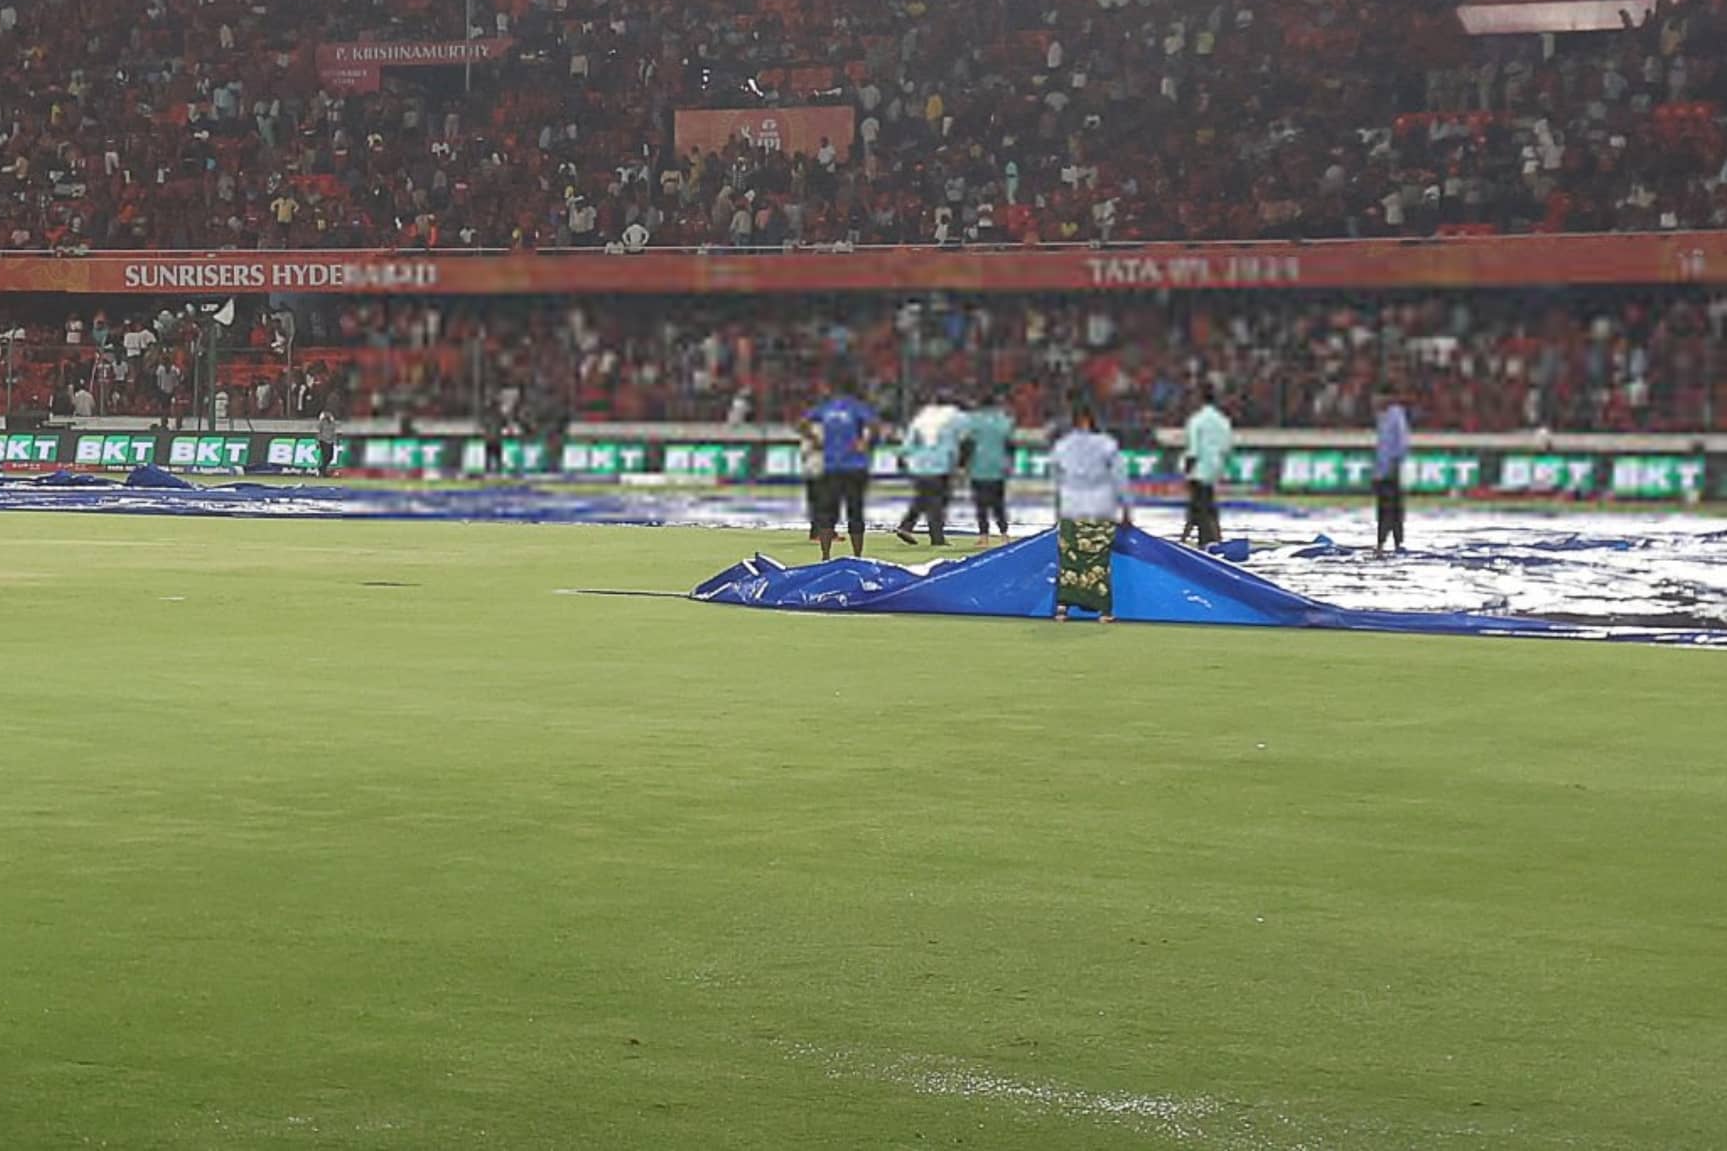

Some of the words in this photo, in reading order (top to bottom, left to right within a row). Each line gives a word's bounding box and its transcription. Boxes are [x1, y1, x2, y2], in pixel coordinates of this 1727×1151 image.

[124, 264, 266, 287] SUNRISERS
[76, 440, 154, 461] BKT
[170, 442, 247, 462] BKT
